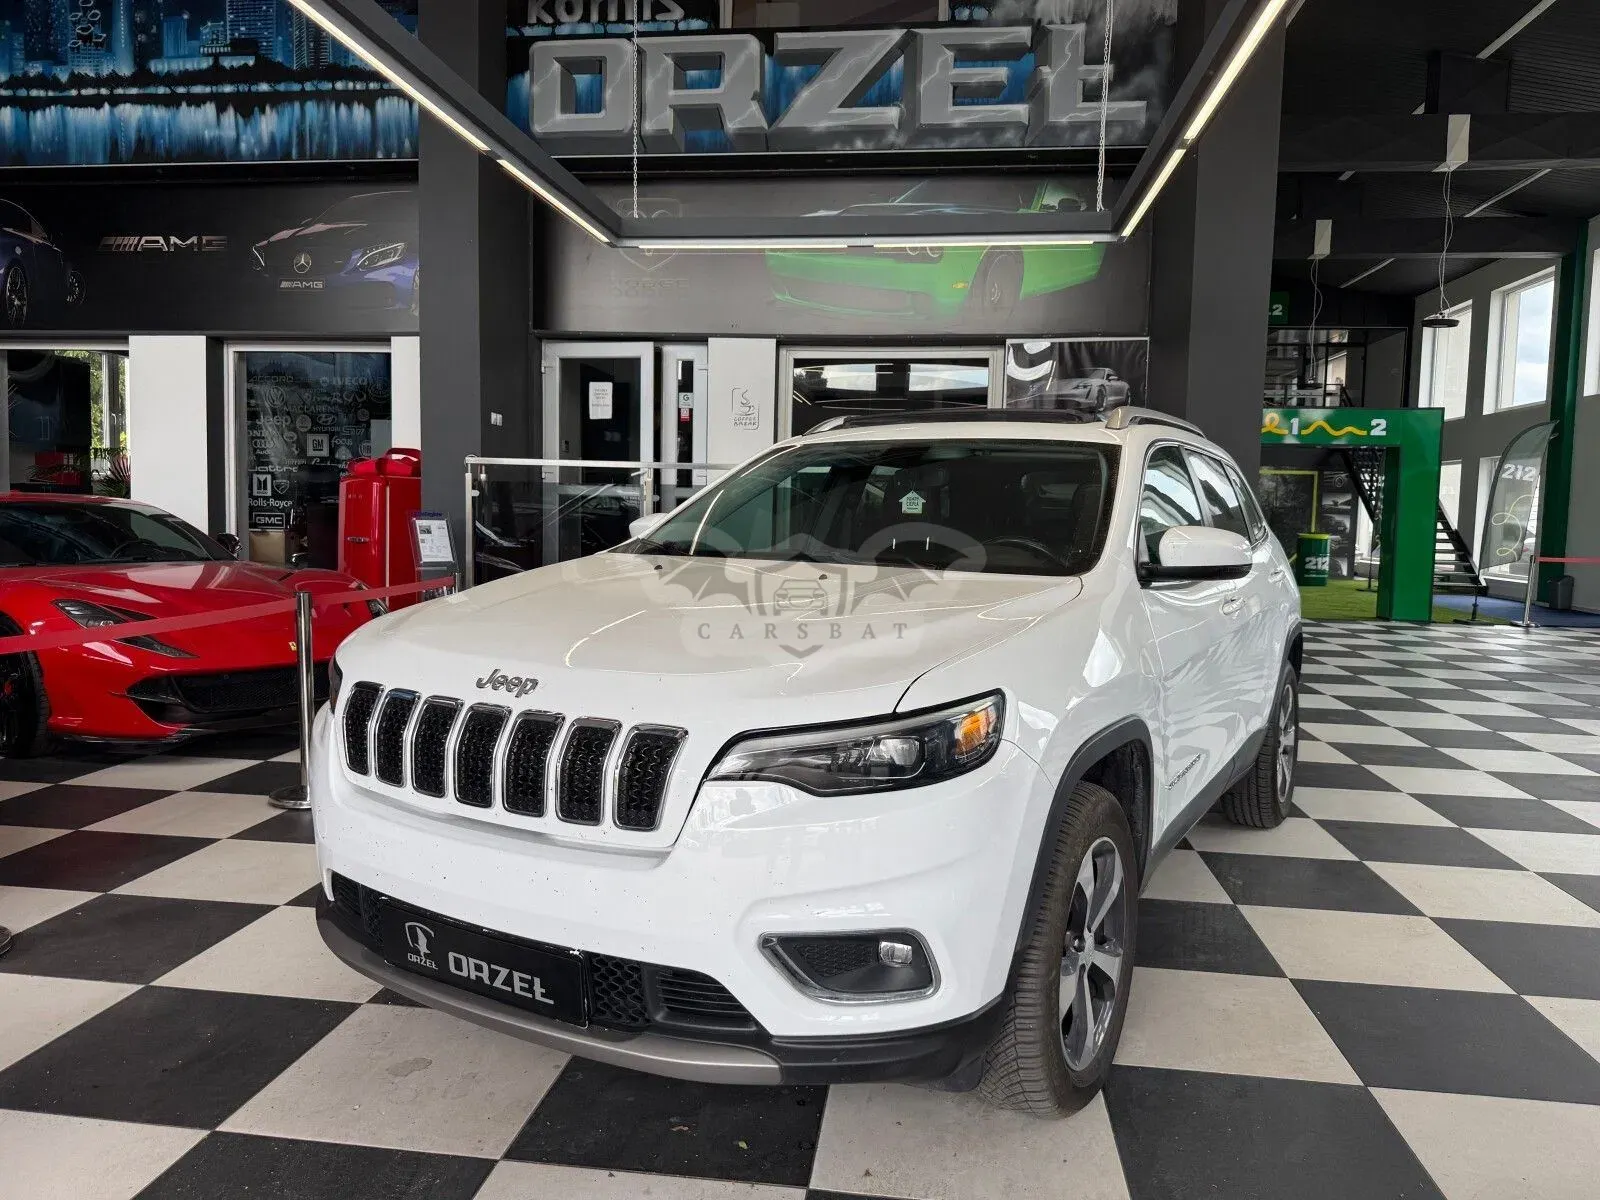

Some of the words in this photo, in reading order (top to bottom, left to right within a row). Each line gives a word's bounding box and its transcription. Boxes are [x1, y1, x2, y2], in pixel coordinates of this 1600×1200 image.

[528, 23, 1148, 153] ORZEŁ
[292, 281, 323, 289] AMG
[312, 438, 324, 449] GM
[1501, 463, 1537, 482] 212
[248, 498, 293, 508] Rolls-Royce
[255, 516, 283, 524] GMC
[475, 668, 540, 698] Jeep
[447, 951, 556, 1005] ORZEŁ
